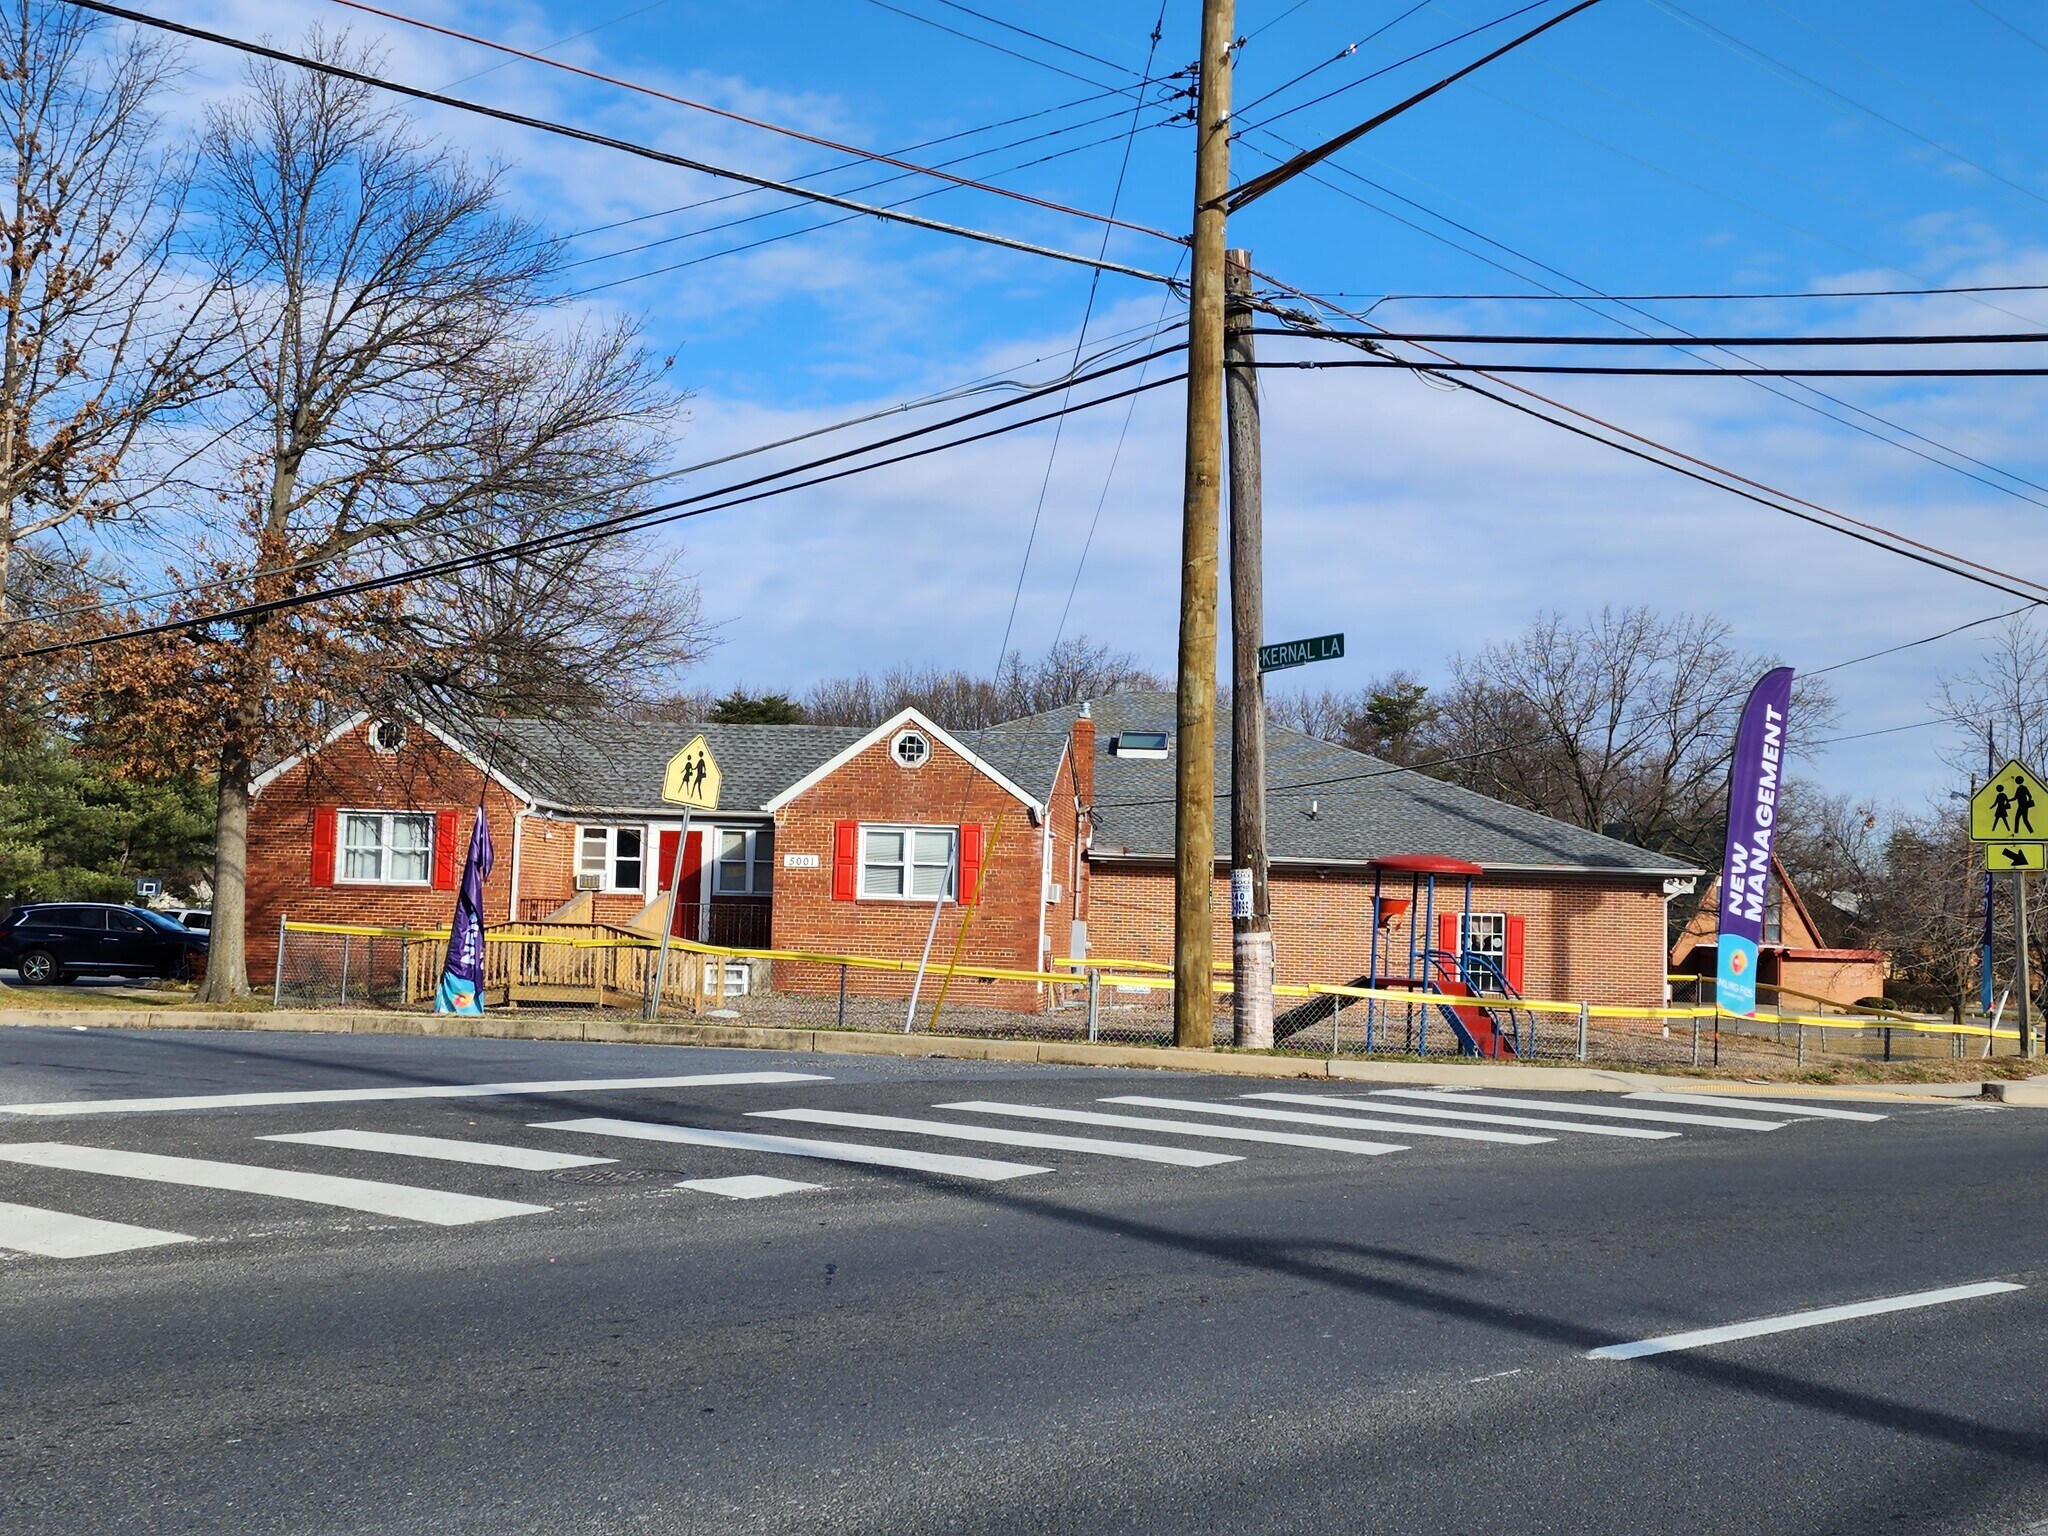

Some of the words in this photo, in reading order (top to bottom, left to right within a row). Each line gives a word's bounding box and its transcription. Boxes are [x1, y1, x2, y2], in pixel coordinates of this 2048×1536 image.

[1262, 642, 1315, 666] KERNAL
[1322, 637, 1341, 657] LA
[1744, 703, 1783, 923] MANAGEMENT
[788, 856, 814, 866] 5001
[1728, 842, 1749, 916] NEW
